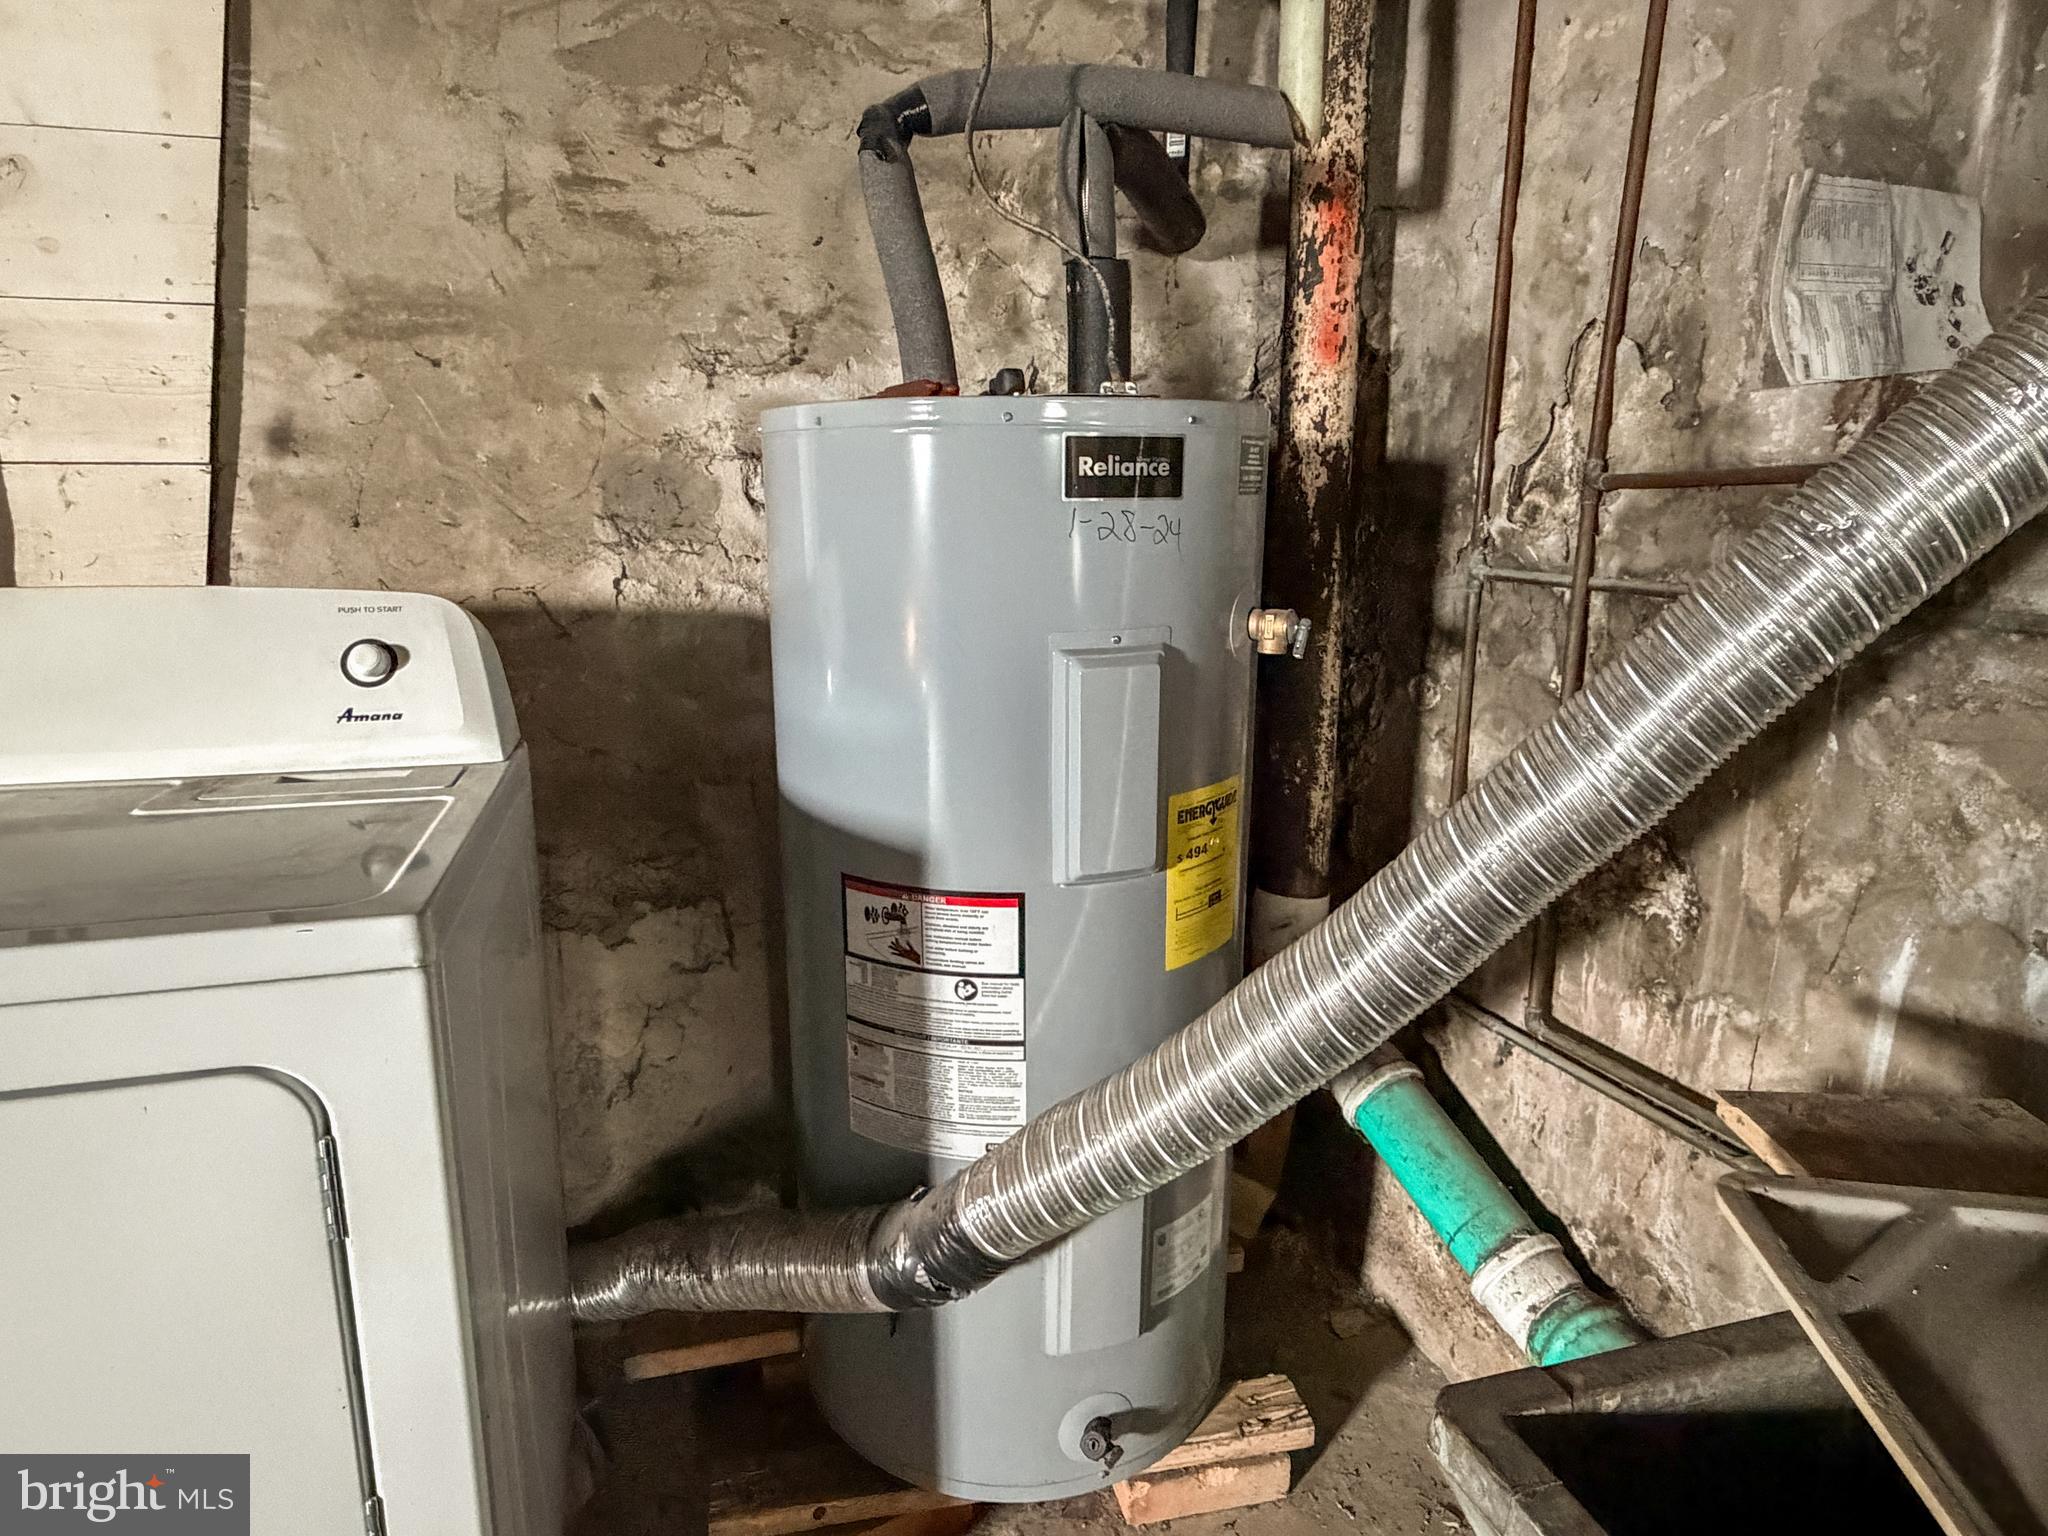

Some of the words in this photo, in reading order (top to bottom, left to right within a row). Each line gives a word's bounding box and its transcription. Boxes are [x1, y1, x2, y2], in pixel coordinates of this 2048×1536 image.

[1078, 454, 1171, 477] Reliance
[1069, 508, 1181, 551] 1-28-24
[338, 606, 361, 614] PUSH
[377, 605, 402, 613] START
[336, 707, 404, 724] Amana
[911, 894, 947, 905] DANGER
